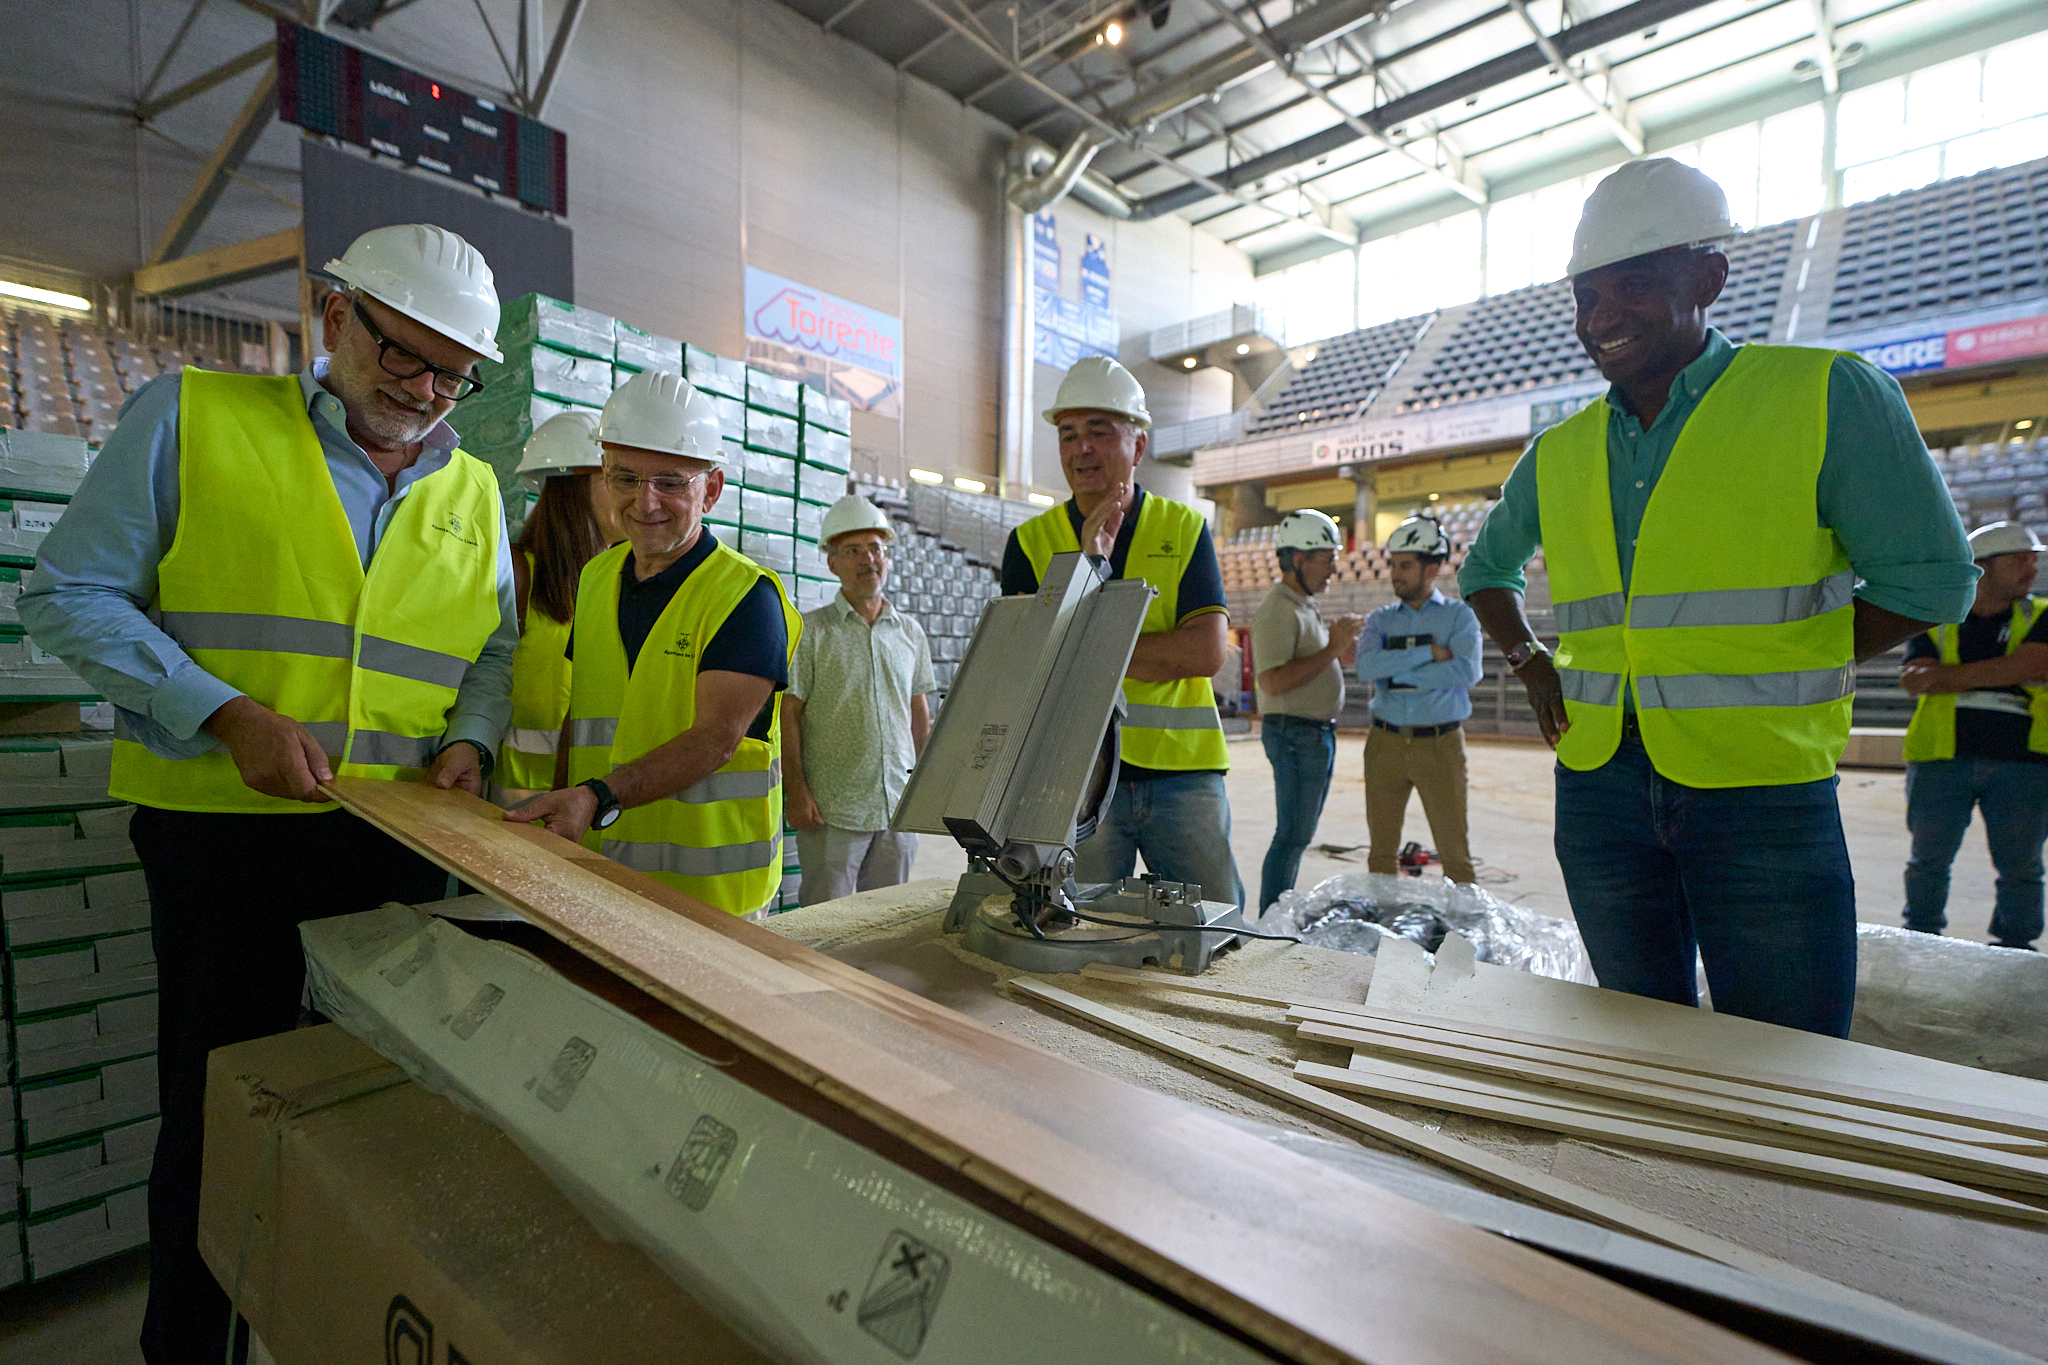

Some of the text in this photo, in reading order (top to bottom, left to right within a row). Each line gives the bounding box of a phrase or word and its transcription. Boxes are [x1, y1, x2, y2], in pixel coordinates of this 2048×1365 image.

[369, 79, 411, 106] LOCAL
[785, 297, 895, 360] Torrente
[1857, 336, 1946, 370] EGRE
